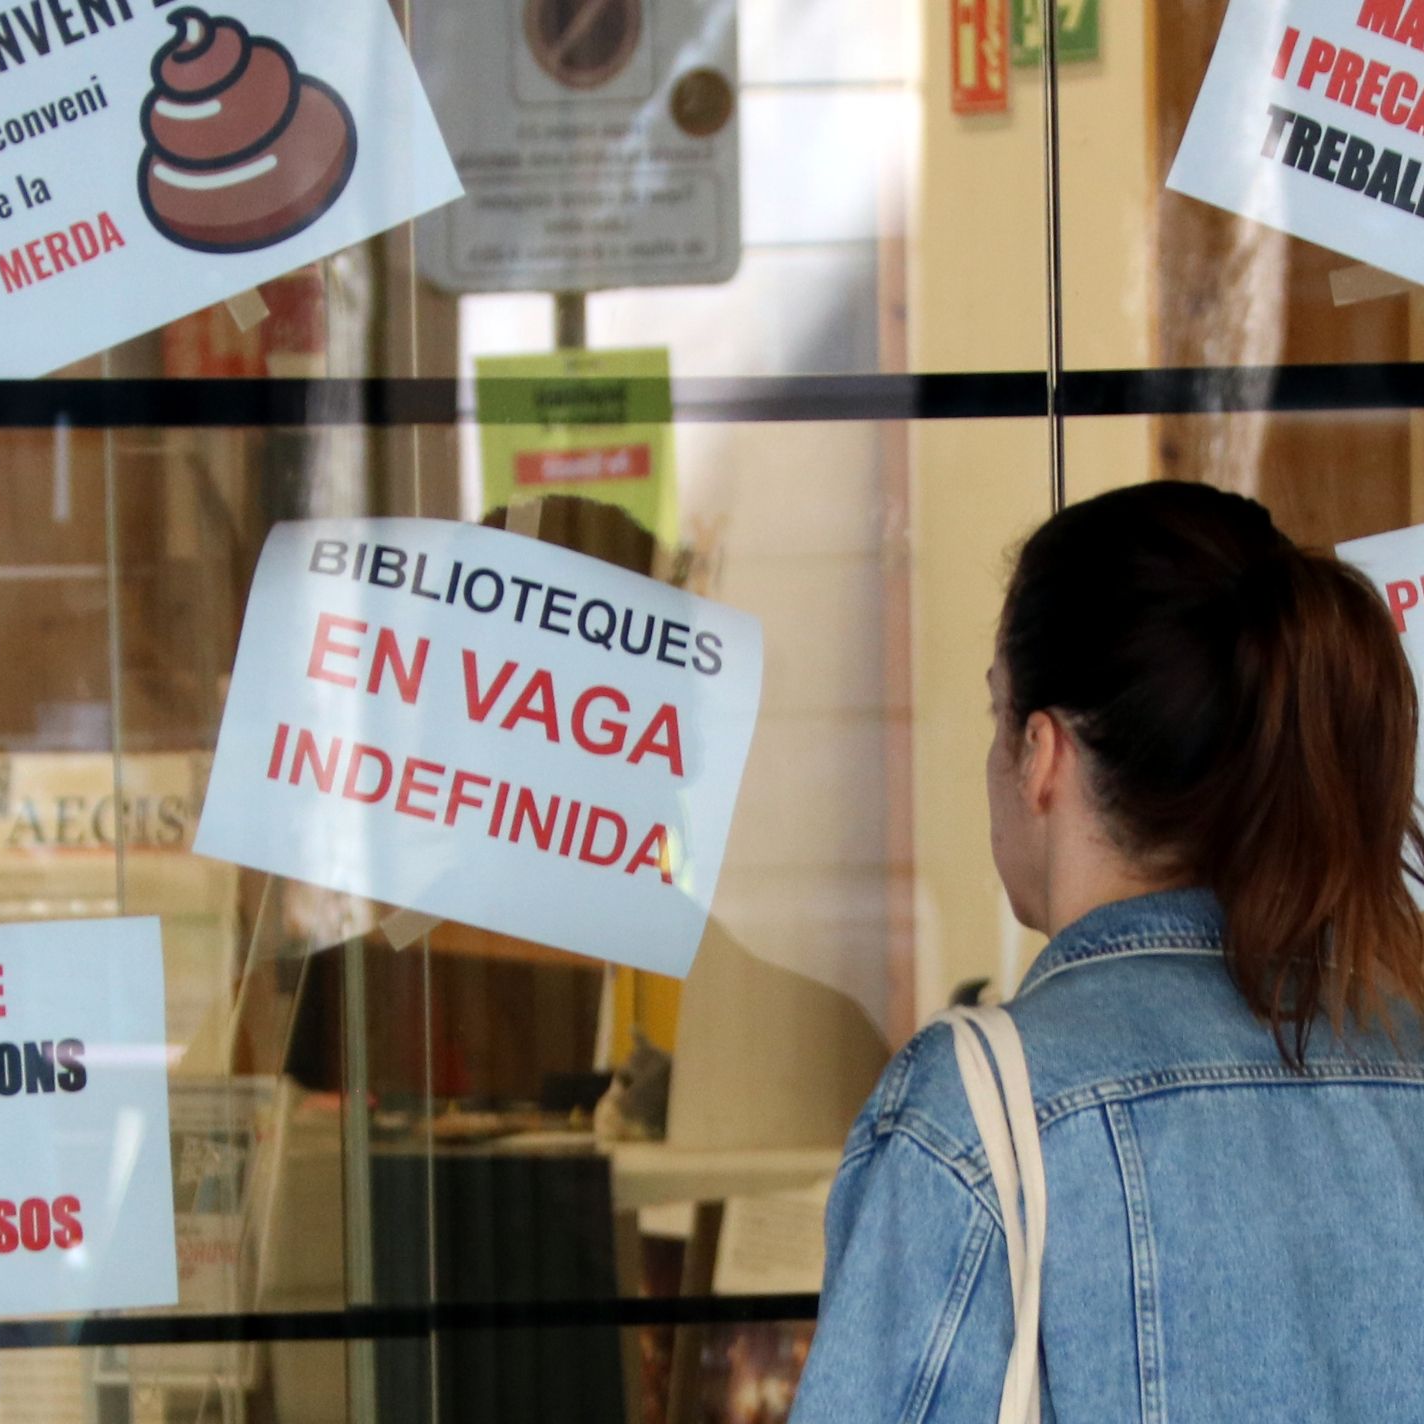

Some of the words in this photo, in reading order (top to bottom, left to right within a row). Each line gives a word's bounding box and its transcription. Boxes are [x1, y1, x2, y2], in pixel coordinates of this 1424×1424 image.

[1271, 26, 1300, 81] I
[16, 172, 51, 209] la
[308, 538, 724, 677] BIBLIOTEQUES
[306, 612, 430, 706] EN
[460, 648, 685, 778] VAGA
[8, 794, 186, 847] AEGIS
[266, 722, 674, 885] INDEFINIDA
